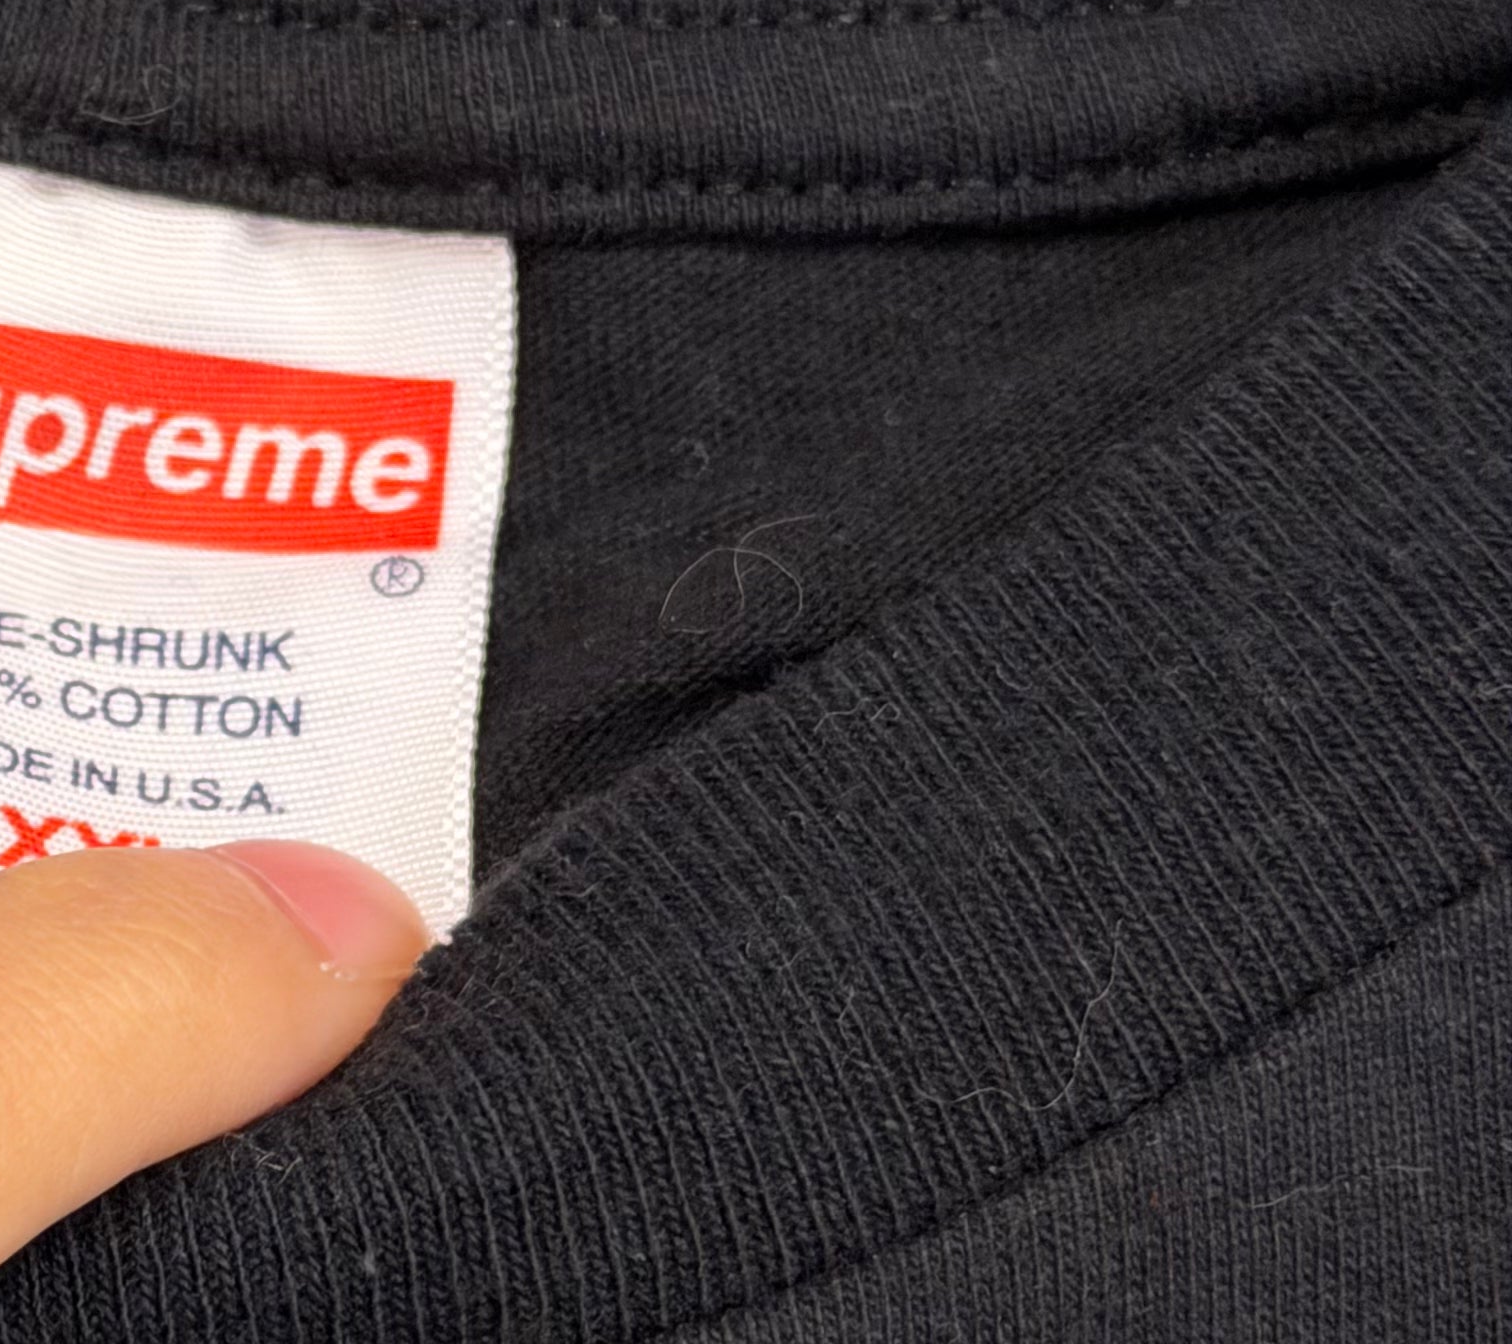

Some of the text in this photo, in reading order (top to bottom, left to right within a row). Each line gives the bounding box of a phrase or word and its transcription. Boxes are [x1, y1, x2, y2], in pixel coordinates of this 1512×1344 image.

[59, 680, 303, 738] COTTON
[70, 759, 118, 795] IN
[137, 773, 287, 815] U.S.A.
